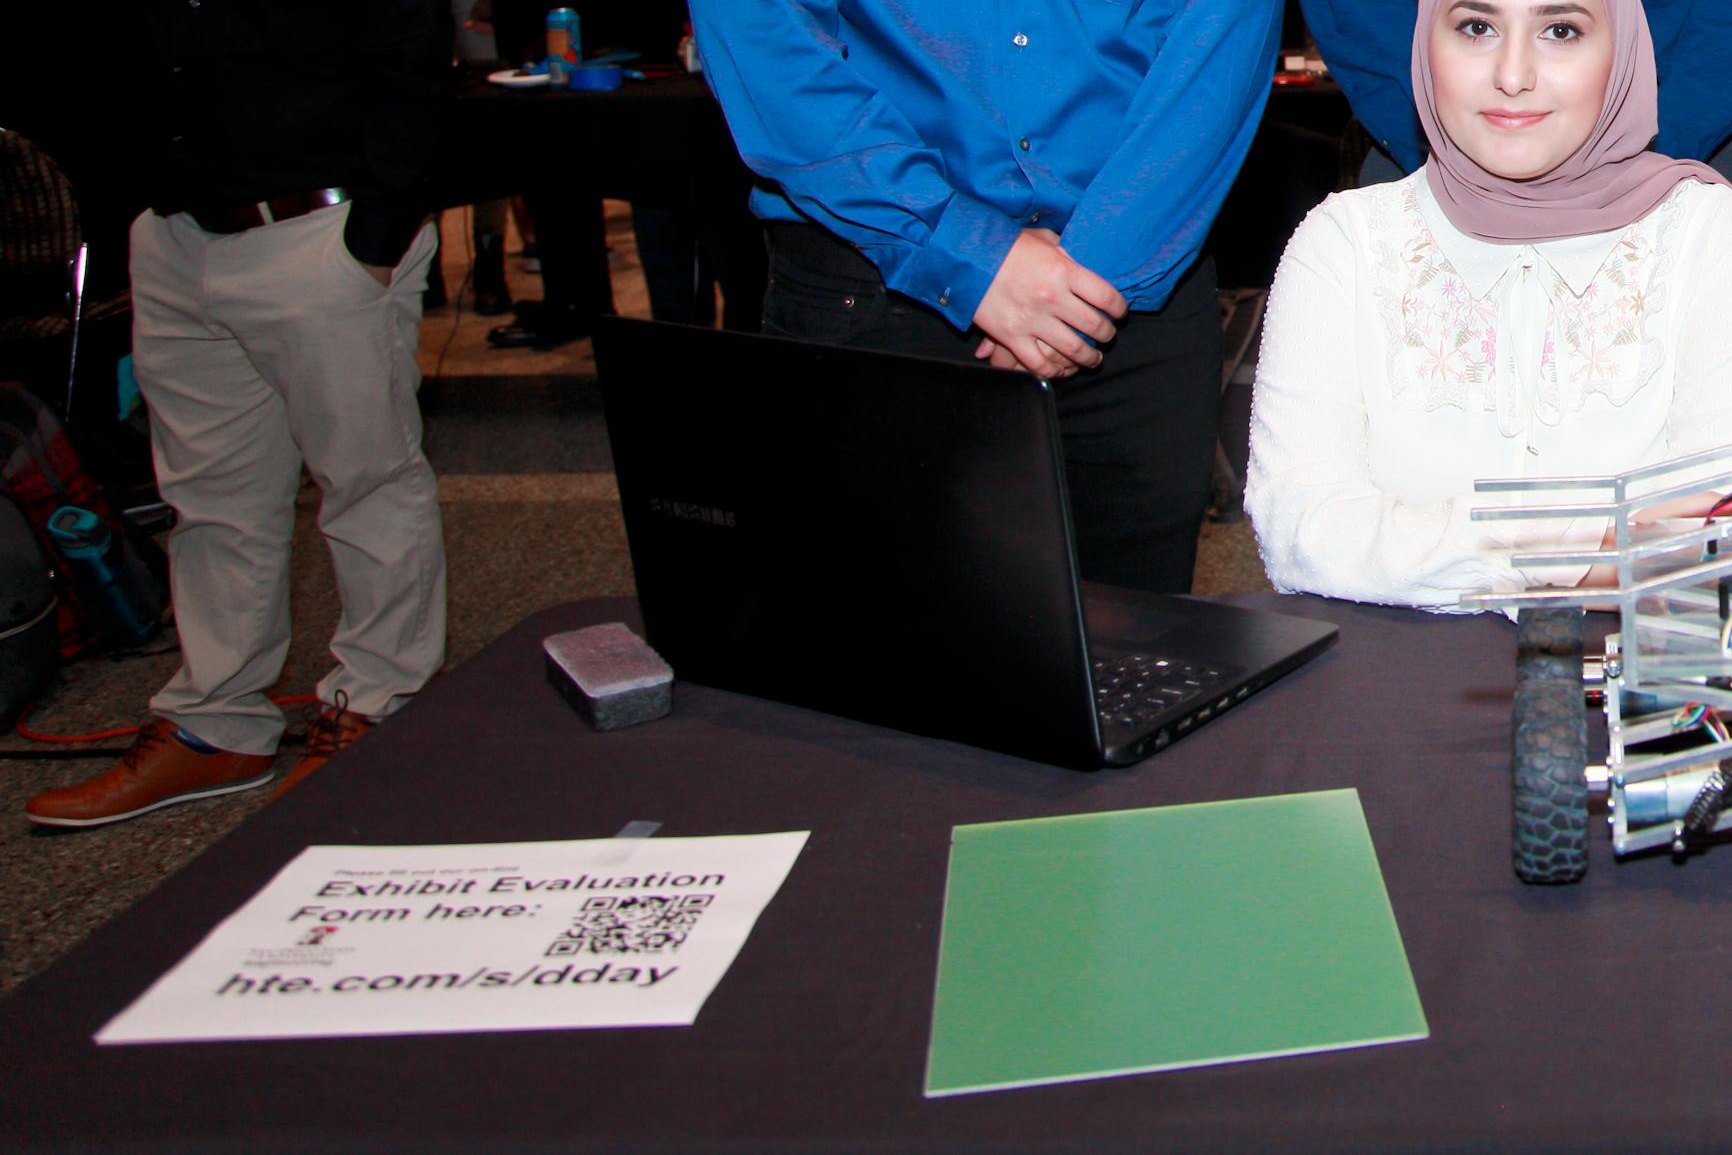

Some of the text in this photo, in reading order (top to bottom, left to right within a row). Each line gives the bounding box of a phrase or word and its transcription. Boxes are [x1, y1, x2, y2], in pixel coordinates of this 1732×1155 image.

[647, 496, 737, 528] SAMSUNG
[315, 872, 726, 897] Exhibit Evaluation
[288, 903, 543, 923] Form here:
[215, 963, 680, 997] hte.com/s/dday
